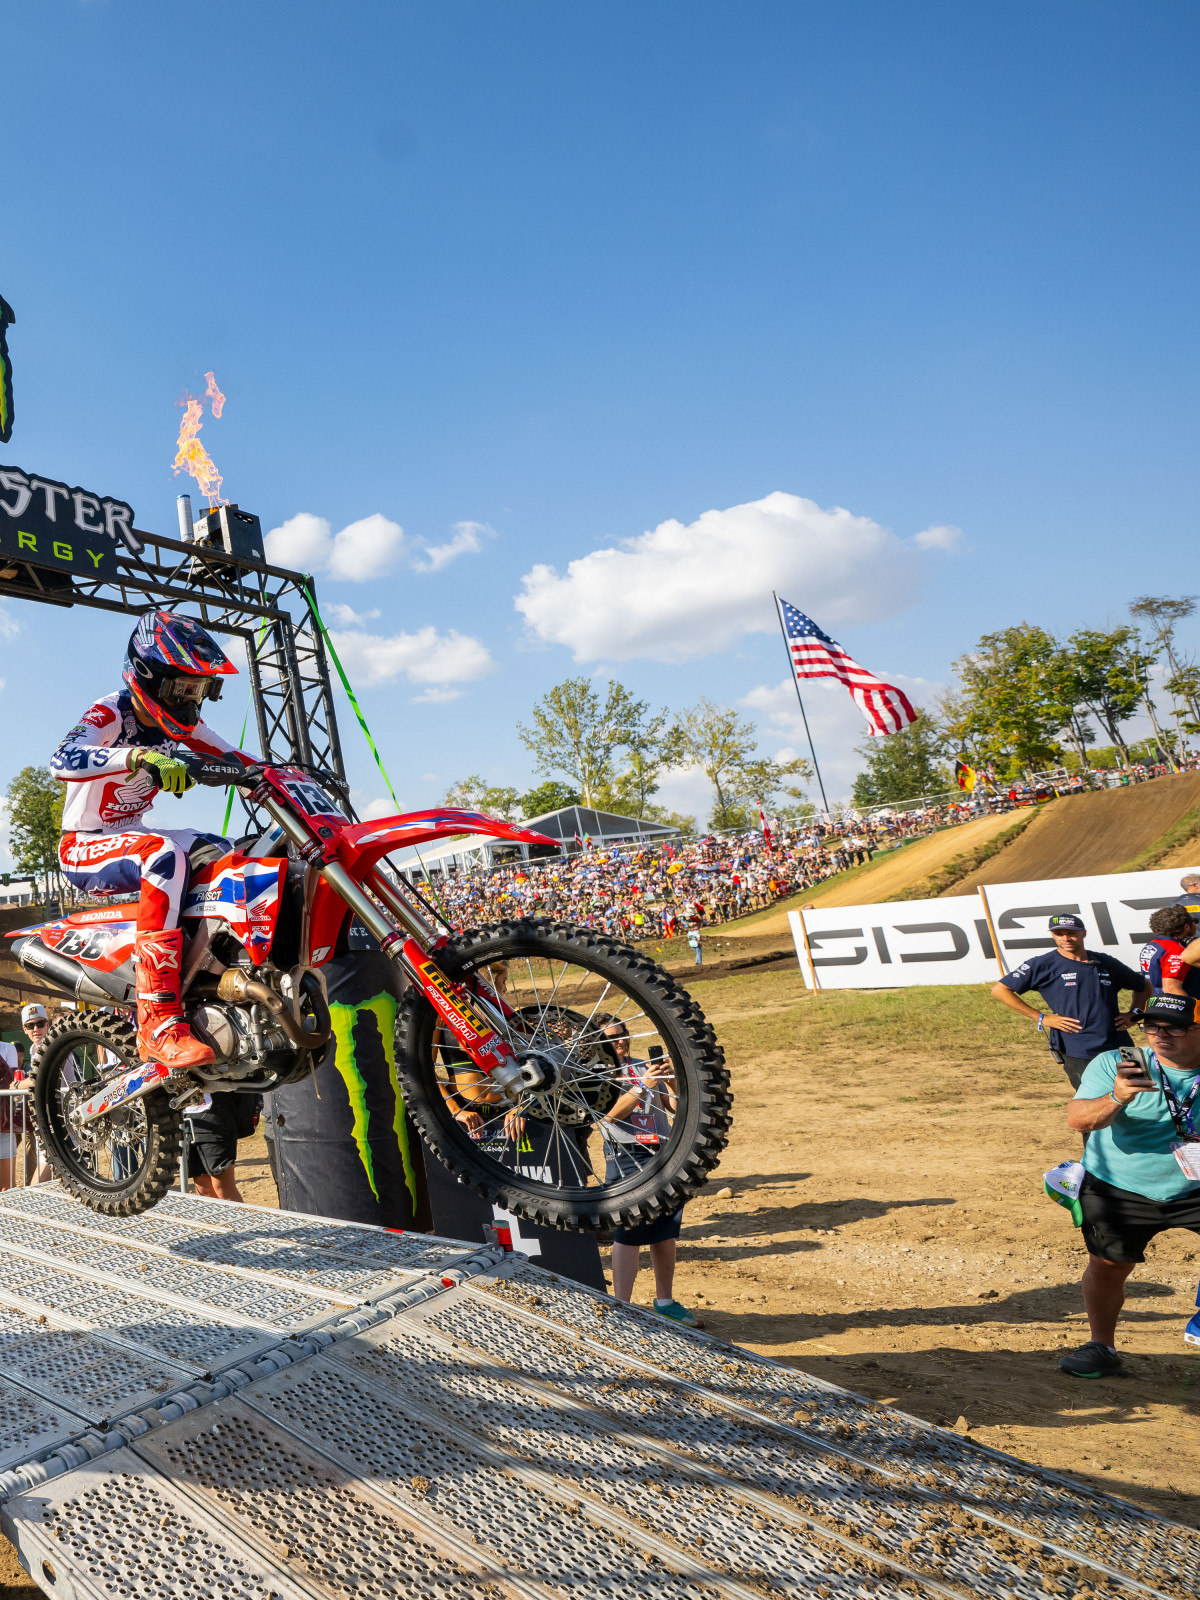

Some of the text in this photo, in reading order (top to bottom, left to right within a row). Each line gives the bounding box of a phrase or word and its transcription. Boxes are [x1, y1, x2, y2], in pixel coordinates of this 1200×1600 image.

[201, 764, 240, 774] ACERBIS
[286, 783, 340, 816] 13
[80, 911, 123, 921] HONDA
[804, 918, 998, 967] SIDI
[423, 963, 489, 1035] PIRELLI
[447, 1011, 478, 1041] infront
[82, 1187, 122, 1200] SCORPION
